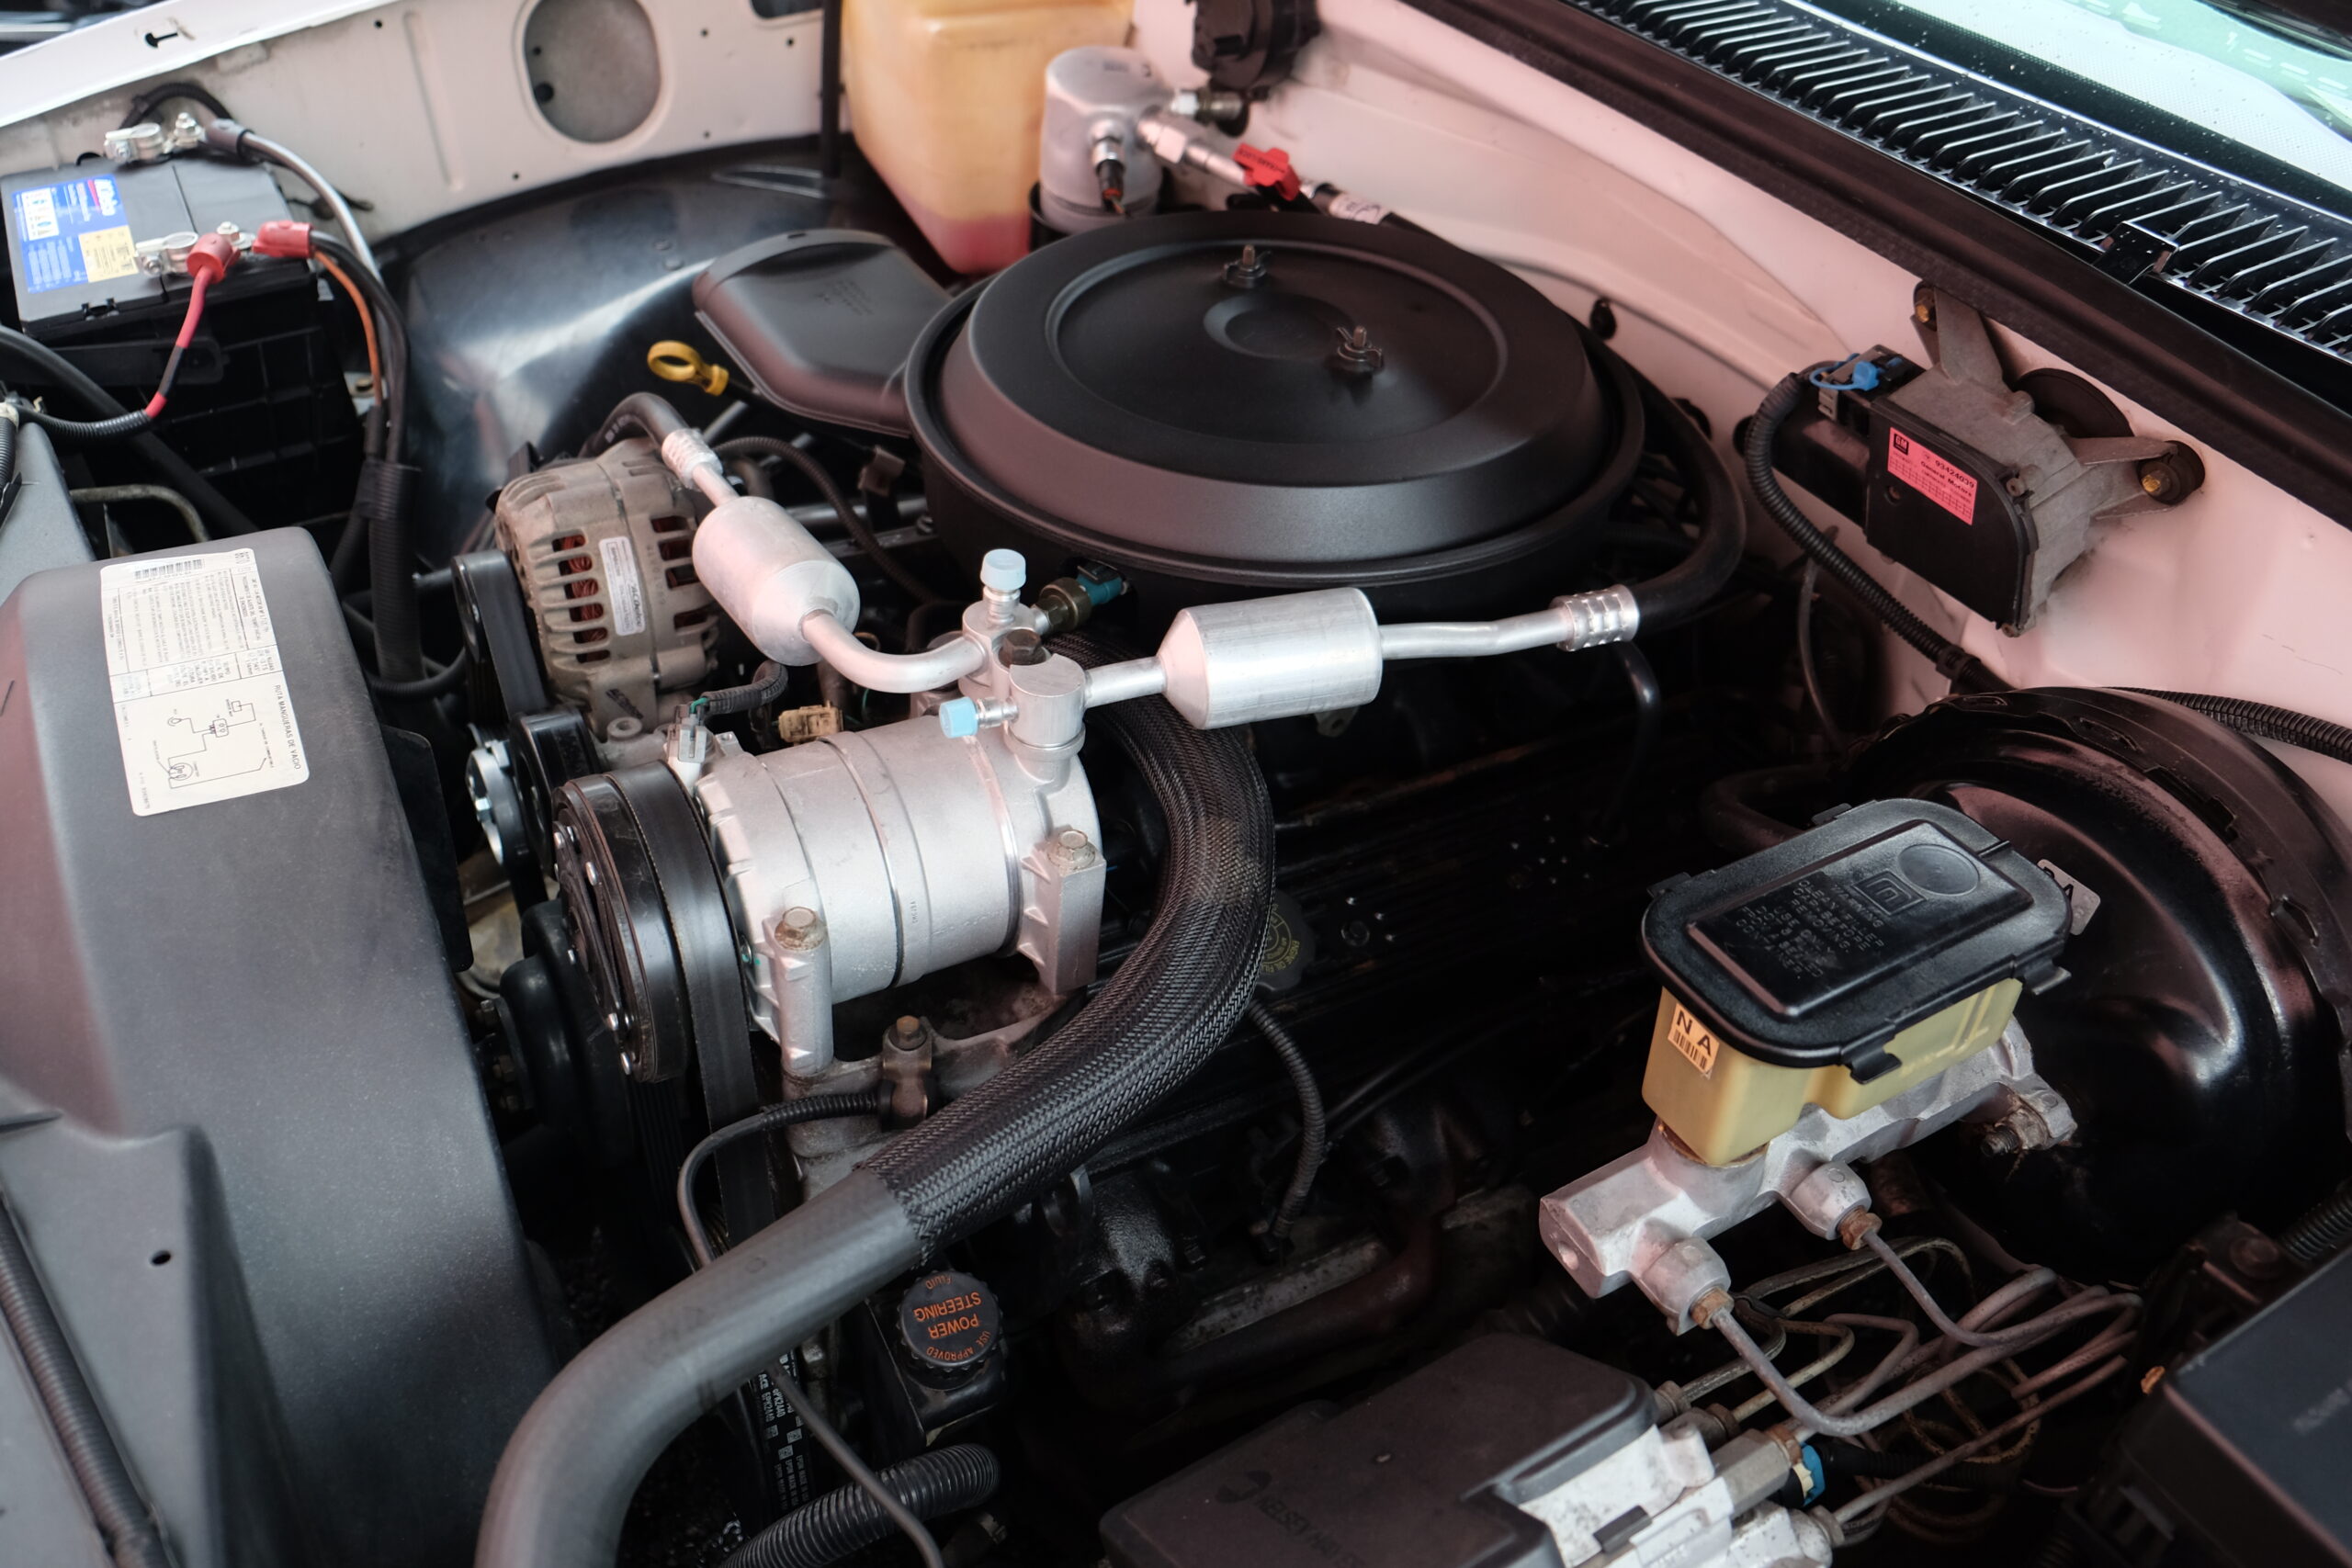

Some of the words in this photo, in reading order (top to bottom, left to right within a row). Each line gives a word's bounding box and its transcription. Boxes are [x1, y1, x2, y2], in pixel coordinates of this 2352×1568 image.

[278, 701, 293, 739] MANGUERAS
[287, 738, 296, 748] DE
[289, 749, 301, 770] VACIO
[1799, 880, 1839, 910] CLEAN
[1841, 912, 1885, 946] FILLER
[1831, 884, 1884, 928] WARNING
[925, 1276, 952, 1289] FLUID
[913, 1292, 981, 1321] STEERING
[928, 1314, 978, 1338] POWER
[976, 1330, 990, 1347] USE
[926, 1347, 974, 1360] APPROVED
